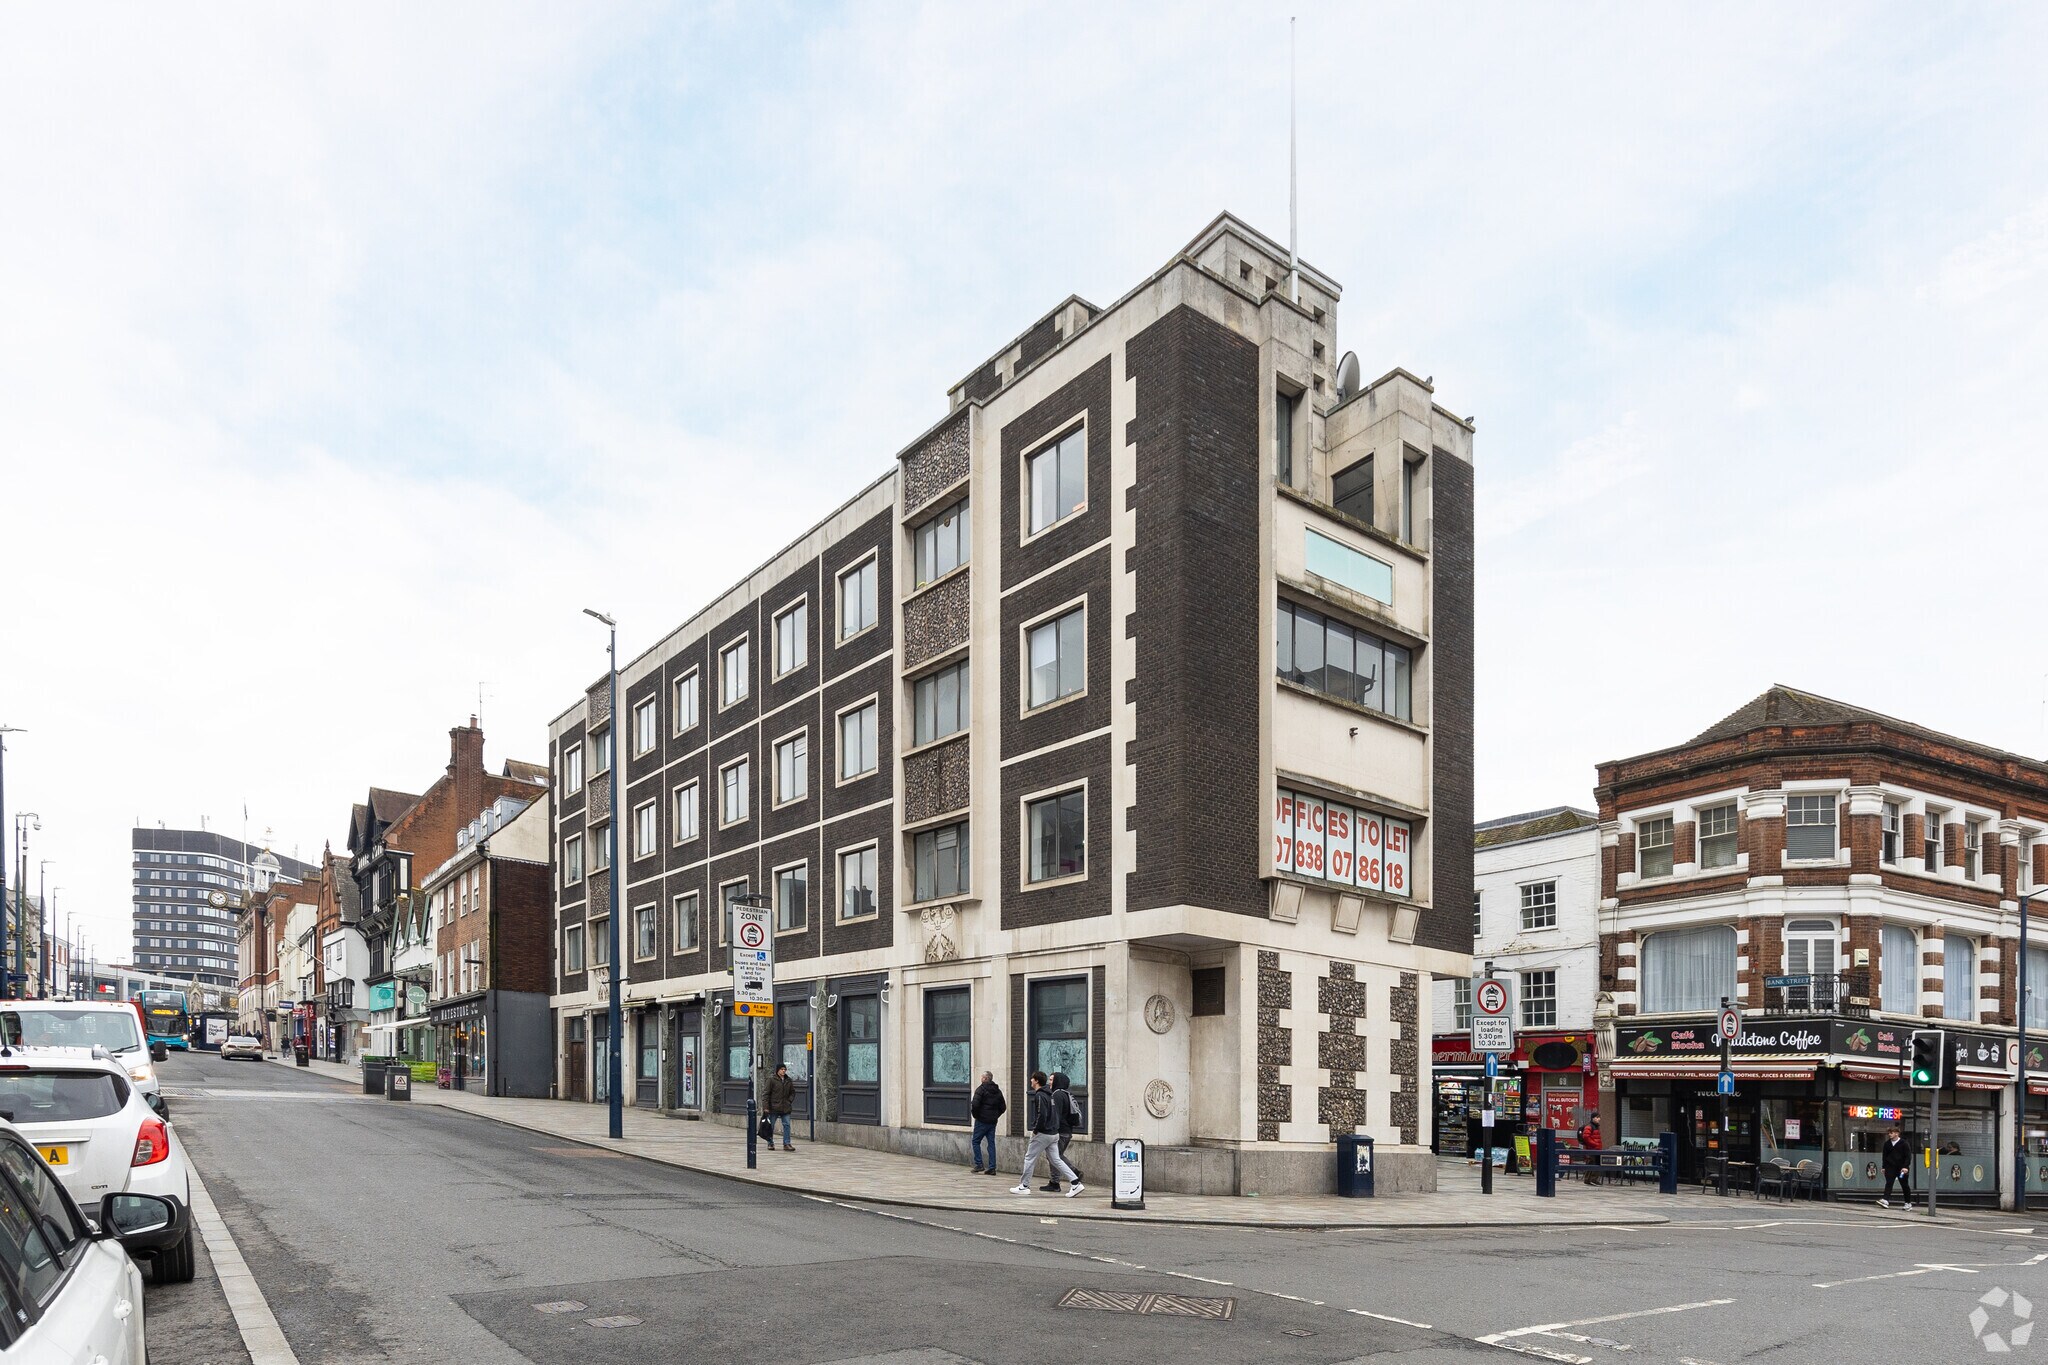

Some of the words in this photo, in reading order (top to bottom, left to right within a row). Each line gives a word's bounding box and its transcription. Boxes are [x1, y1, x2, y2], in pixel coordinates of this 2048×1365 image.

[1358, 817, 1380, 847] TO
[1386, 824, 1408, 854] LET
[736, 906, 768, 914] PEDESTRIAN
[740, 912, 763, 921] ZONE
[1671, 1030, 1694, 1039] Café
[1877, 1031, 1894, 1041] Café
[1780, 1030, 1821, 1050] Coffee
[1671, 1041, 1704, 1049] Mocha
